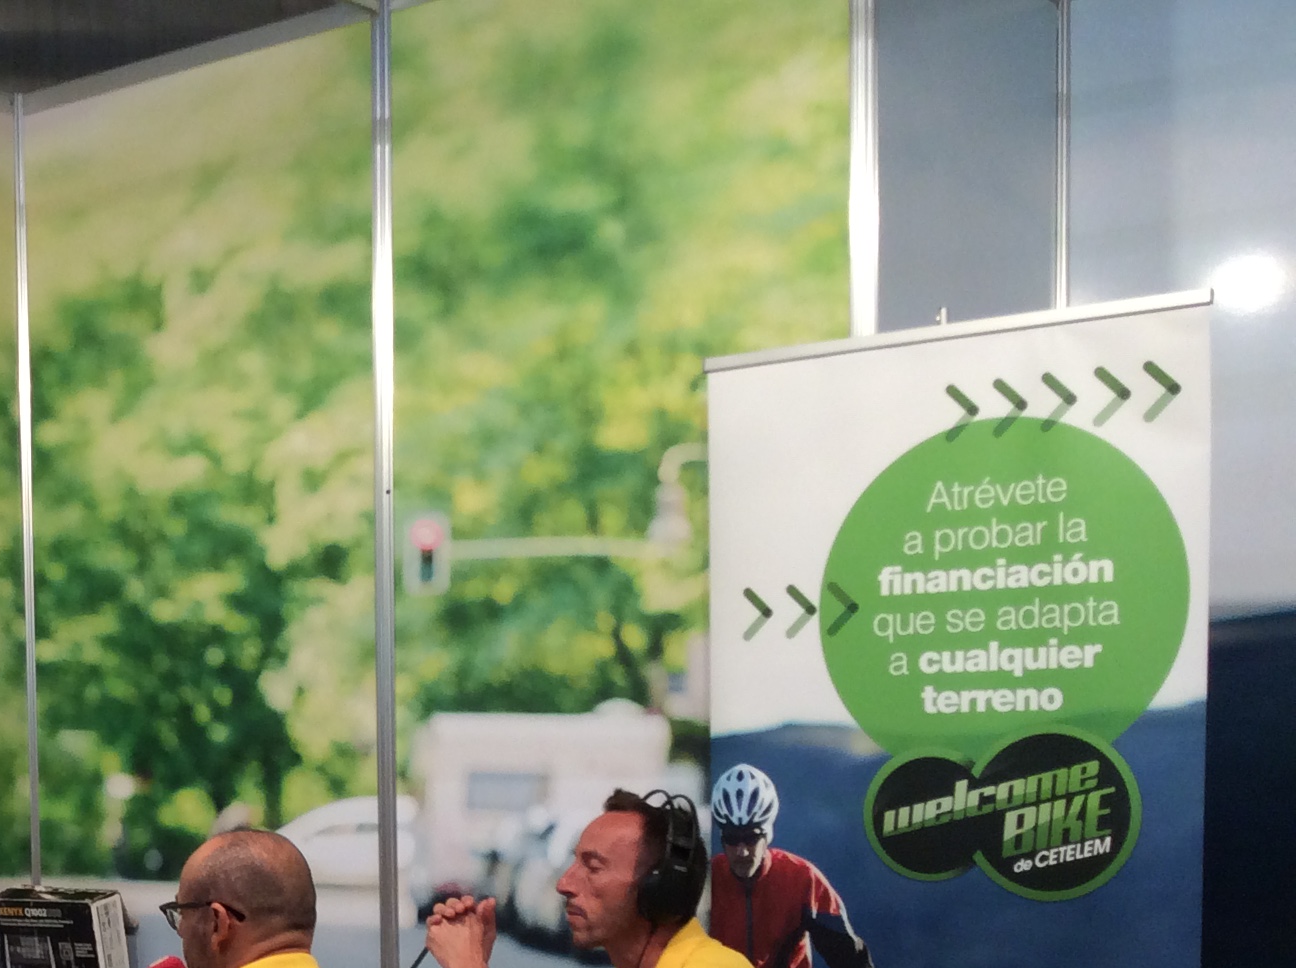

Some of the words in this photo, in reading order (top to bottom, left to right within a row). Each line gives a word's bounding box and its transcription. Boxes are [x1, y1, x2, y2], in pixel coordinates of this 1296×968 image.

[926, 473, 1068, 513] Atrévete
[903, 531, 924, 555] a
[934, 517, 1049, 561] probar
[1058, 511, 1088, 544] la
[877, 553, 1115, 597] financiación
[872, 610, 936, 644] que
[945, 608, 986, 633] se
[996, 596, 1121, 636] adapta
[888, 651, 910, 676] a
[918, 638, 1104, 678] cualquier
[921, 685, 1064, 714] terreno
[882, 760, 1101, 838] welcome
[1002, 787, 1116, 858] BIKE
[1013, 858, 1033, 873] de
[1034, 836, 1112, 869] CETELEM
